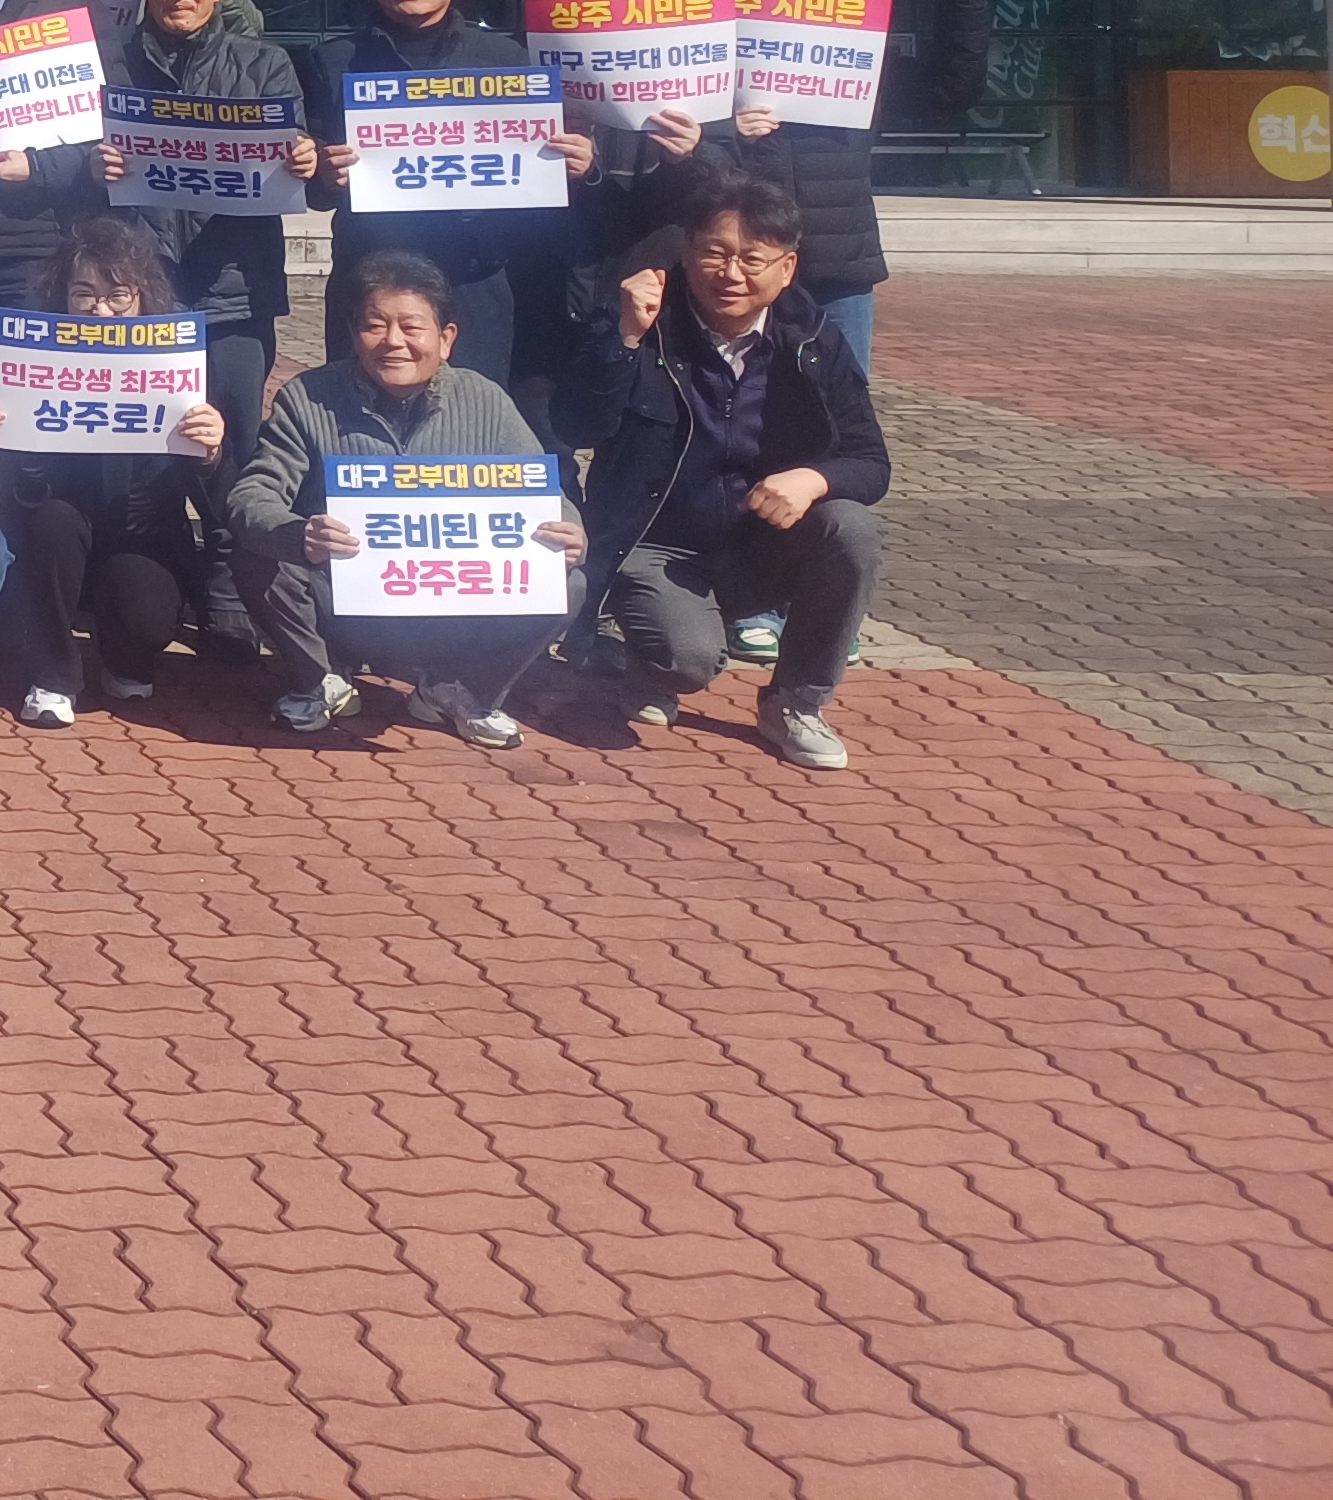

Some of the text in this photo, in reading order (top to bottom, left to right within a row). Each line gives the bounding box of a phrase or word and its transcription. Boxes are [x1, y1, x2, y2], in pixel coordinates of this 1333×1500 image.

[549, 1, 612, 29] 상주
[539, 43, 728, 72] 대구 군부대 이전을
[736, 38, 874, 70] 군부대 이전을
[35, 64, 96, 90] 이전을
[354, 73, 550, 101] 대구 군부대 이전은
[562, 81, 605, 101] 절히
[613, 72, 729, 102] 희망합니다!
[751, 70, 871, 100] 희망합니다!
[109, 95, 284, 124] 대구 군부대 이전은
[356, 119, 556, 146] 민군상생 최적지
[110, 134, 295, 165] 민군상생 최적지
[145, 164, 261, 199] 상주로!
[392, 155, 521, 189] 상주로!
[3, 317, 197, 345] 대구 군부대 이전은
[1, 362, 200, 394] 민군상생 최적지
[34, 400, 165, 434] 상주로!
[337, 463, 547, 489] 대구 군부대 이전은
[365, 512, 526, 550] 준비된 땅
